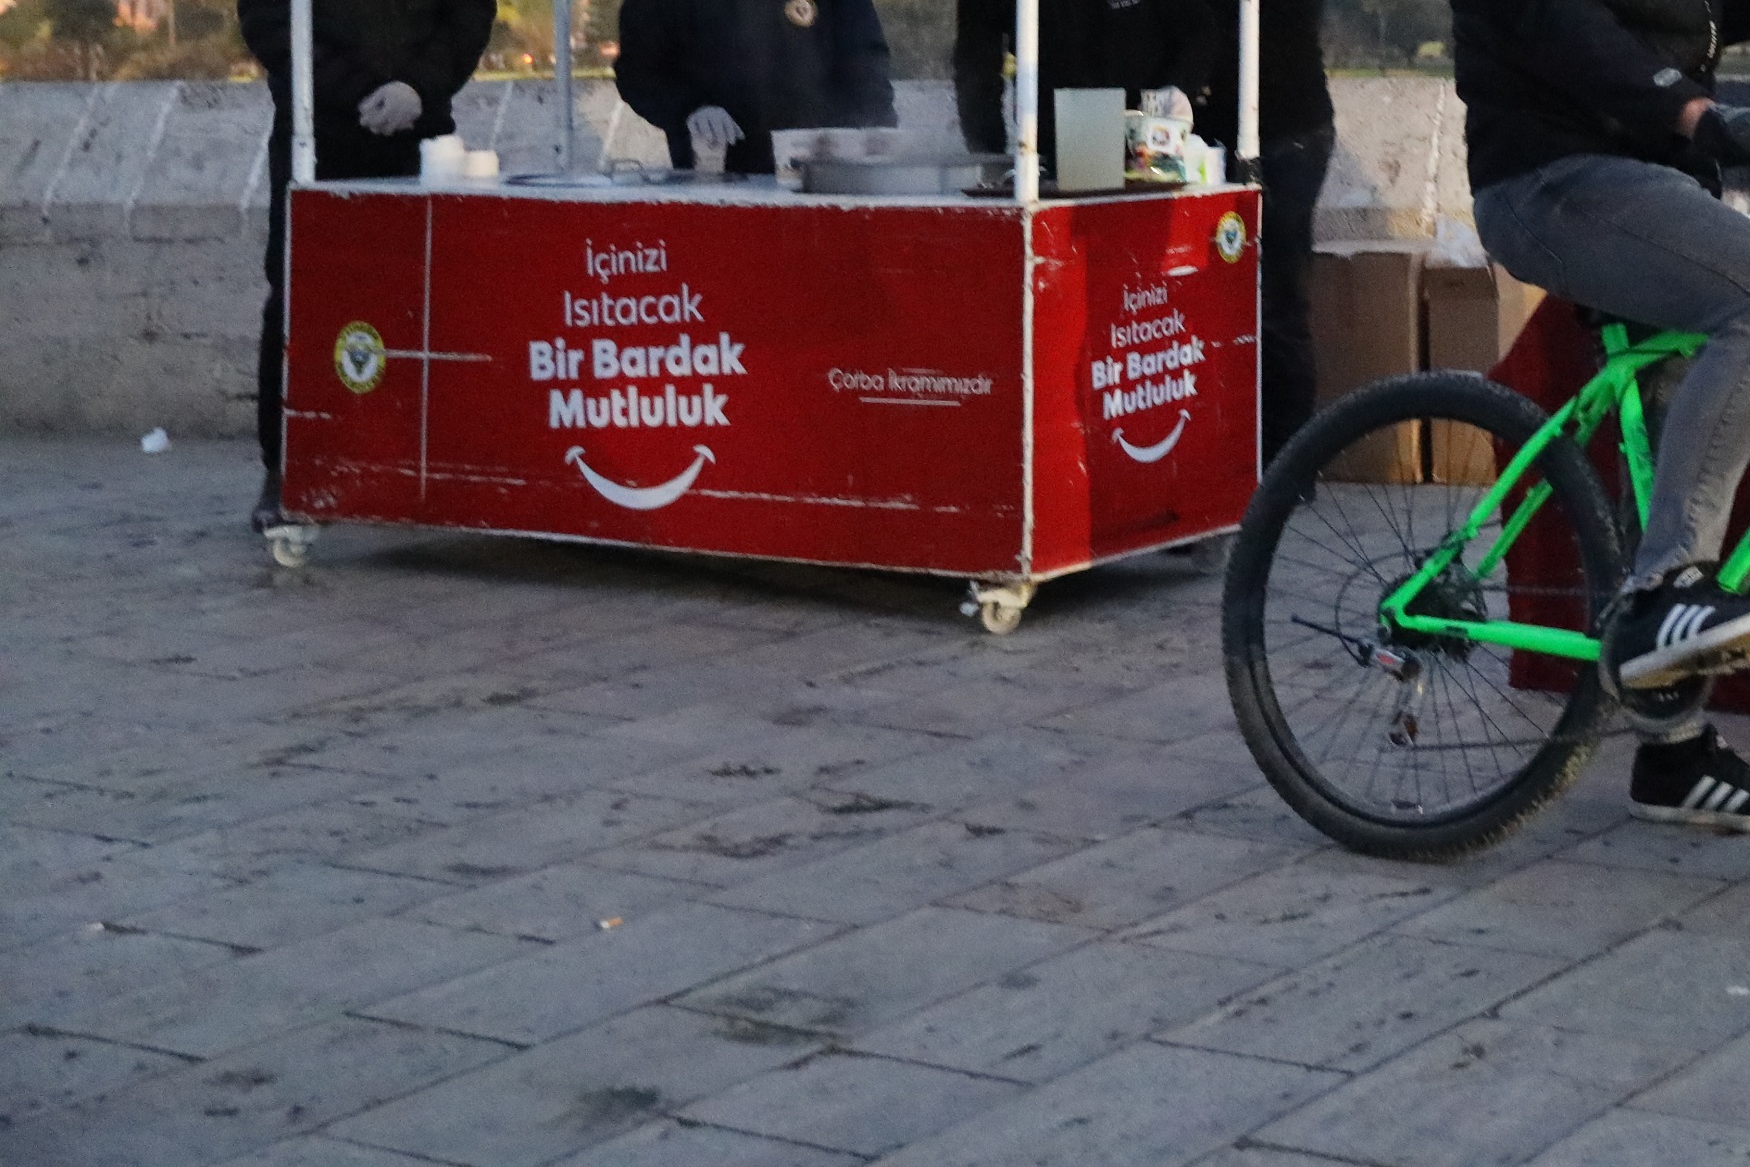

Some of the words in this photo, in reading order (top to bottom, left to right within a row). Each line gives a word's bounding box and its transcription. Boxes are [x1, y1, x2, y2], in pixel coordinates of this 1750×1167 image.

[585, 237, 668, 284] İçinizi
[563, 282, 705, 327] Isıtacak
[1123, 280, 1169, 315] İçinizi
[1111, 308, 1187, 349] Isıtacak
[528, 337, 585, 381] Bir
[591, 331, 749, 380] Bardak
[1091, 355, 1124, 390] Bir
[1126, 335, 1207, 380] Bardak
[548, 383, 732, 429] Mutluluk
[1102, 368, 1199, 420] Mutluluk
